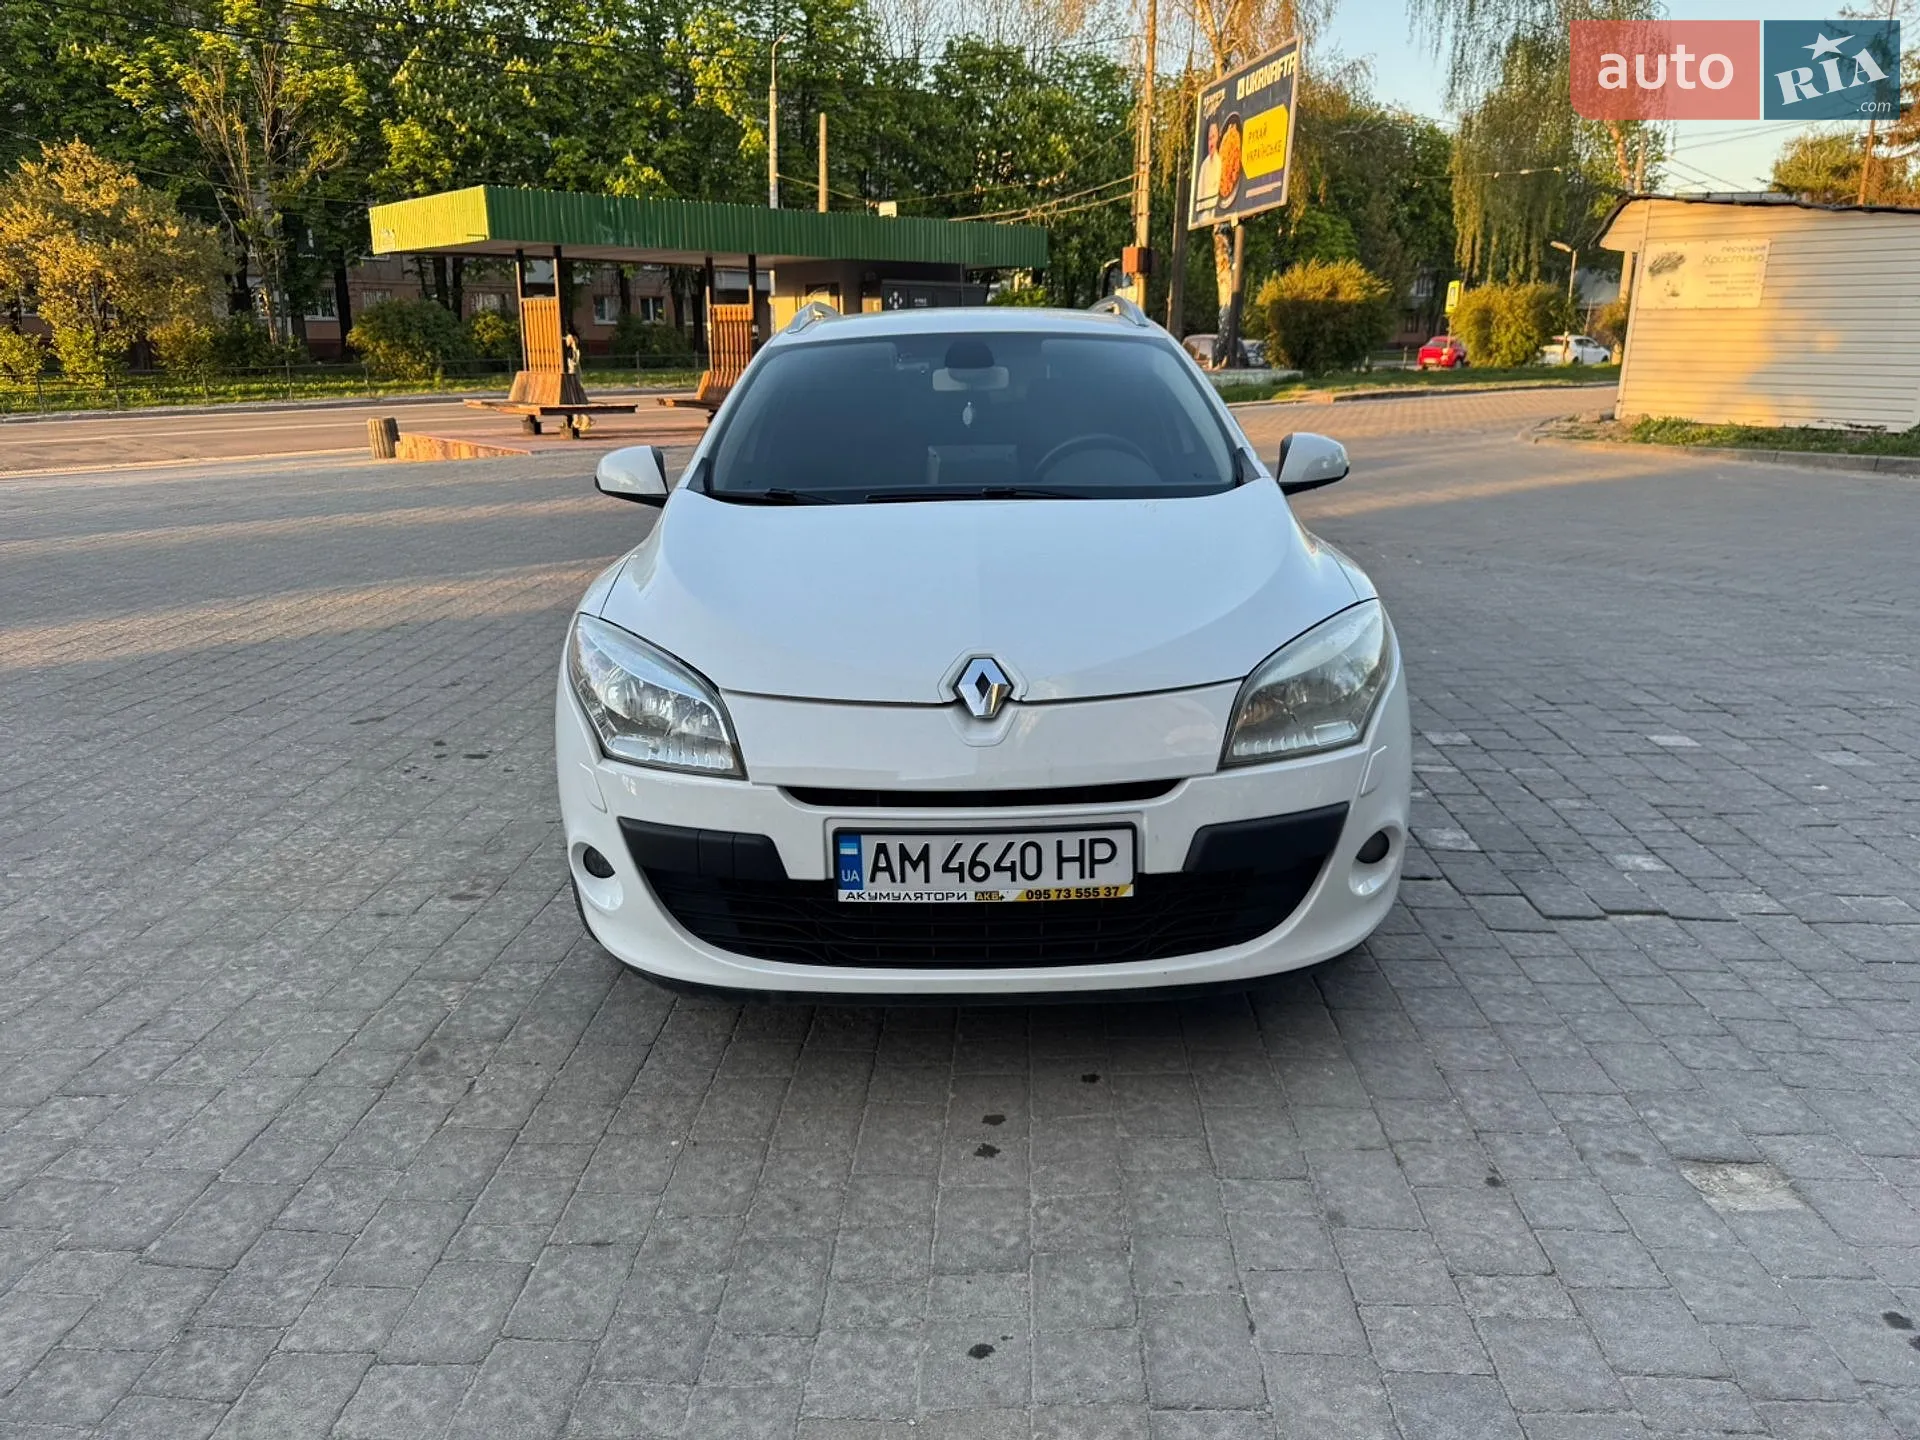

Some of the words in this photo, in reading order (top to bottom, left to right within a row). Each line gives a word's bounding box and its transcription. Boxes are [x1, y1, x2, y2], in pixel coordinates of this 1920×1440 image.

[869, 842, 930, 884] AM
[941, 841, 1042, 883] 4640
[1056, 837, 1118, 881] HP
[841, 868, 860, 882] UA
[845, 891, 968, 901] АКУМУЛЯТОРИ
[1025, 889, 1050, 900] 095
[1055, 889, 1072, 899] 73
[1075, 887, 1099, 898] 555
[1104, 886, 1120, 897] 37
